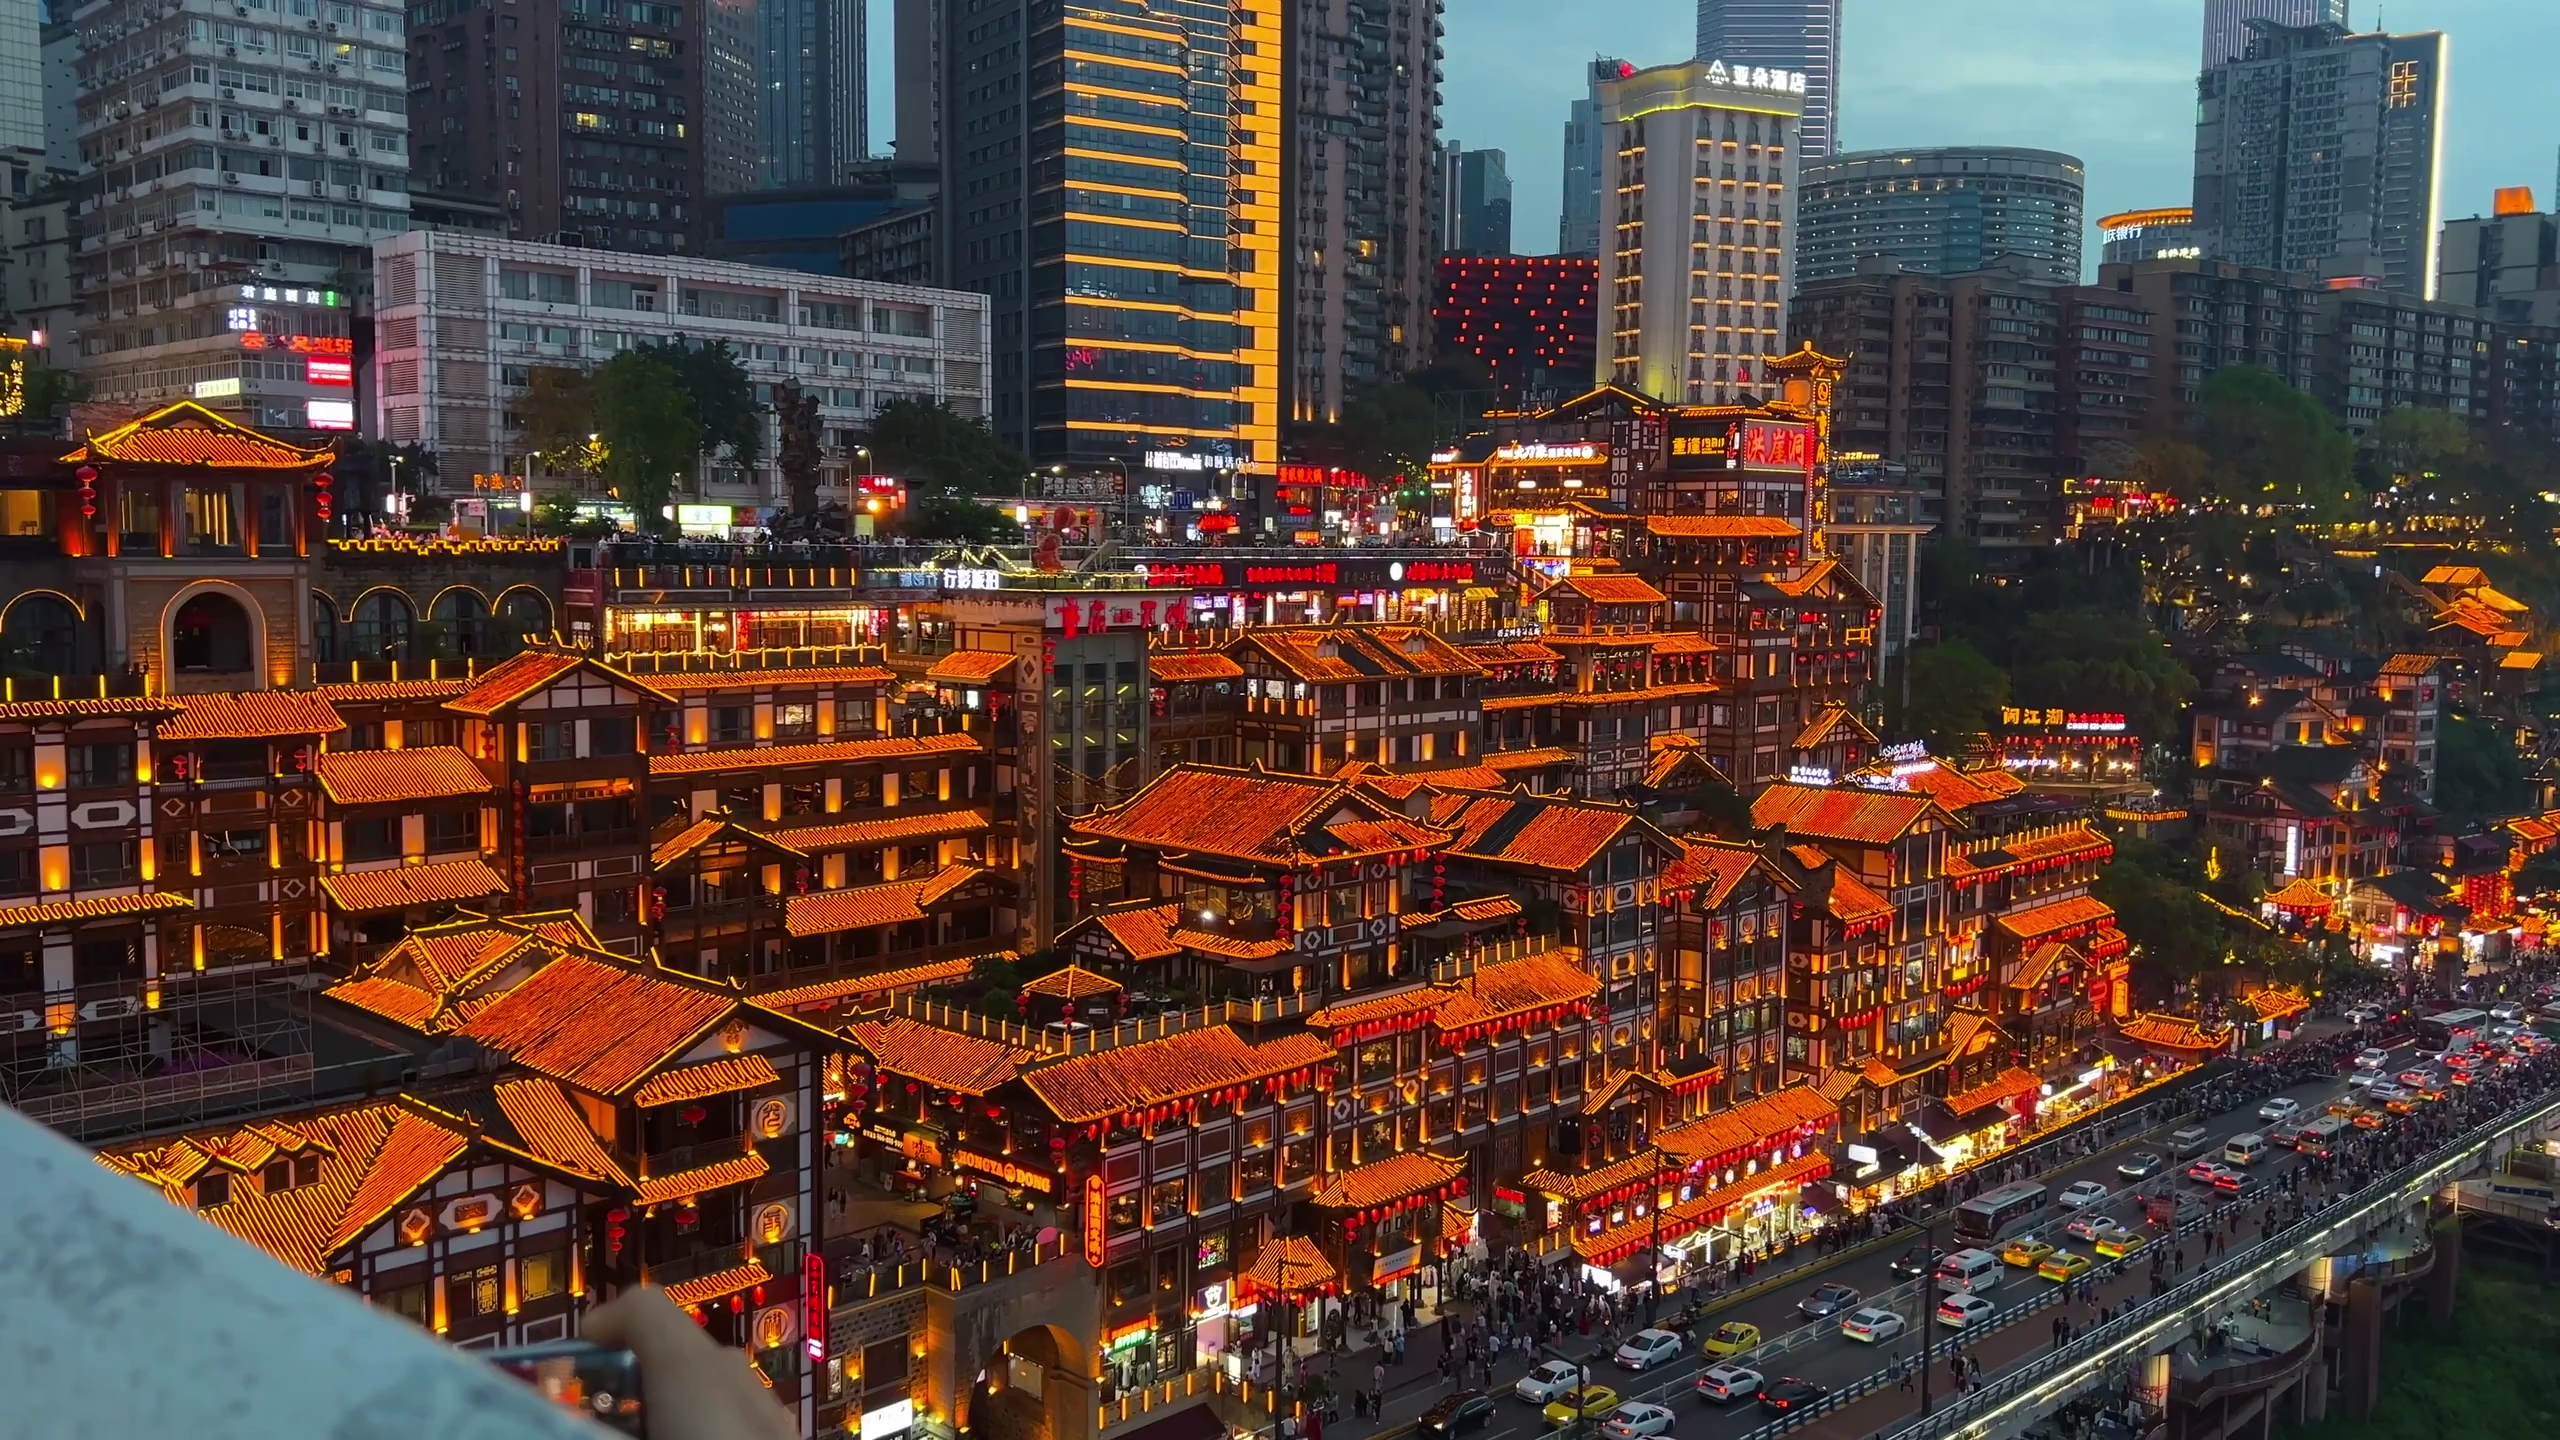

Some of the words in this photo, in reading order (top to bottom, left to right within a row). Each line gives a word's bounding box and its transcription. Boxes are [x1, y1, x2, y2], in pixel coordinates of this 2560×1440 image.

[1733, 65, 1806, 93] 亚朵酒店
[1747, 427, 1805, 466] 洪崖洞
[2002, 706, 2063, 725] 闹江湖
[958, 1150, 1004, 1177] HONGYA
[1016, 1168, 1051, 1193] DONG
